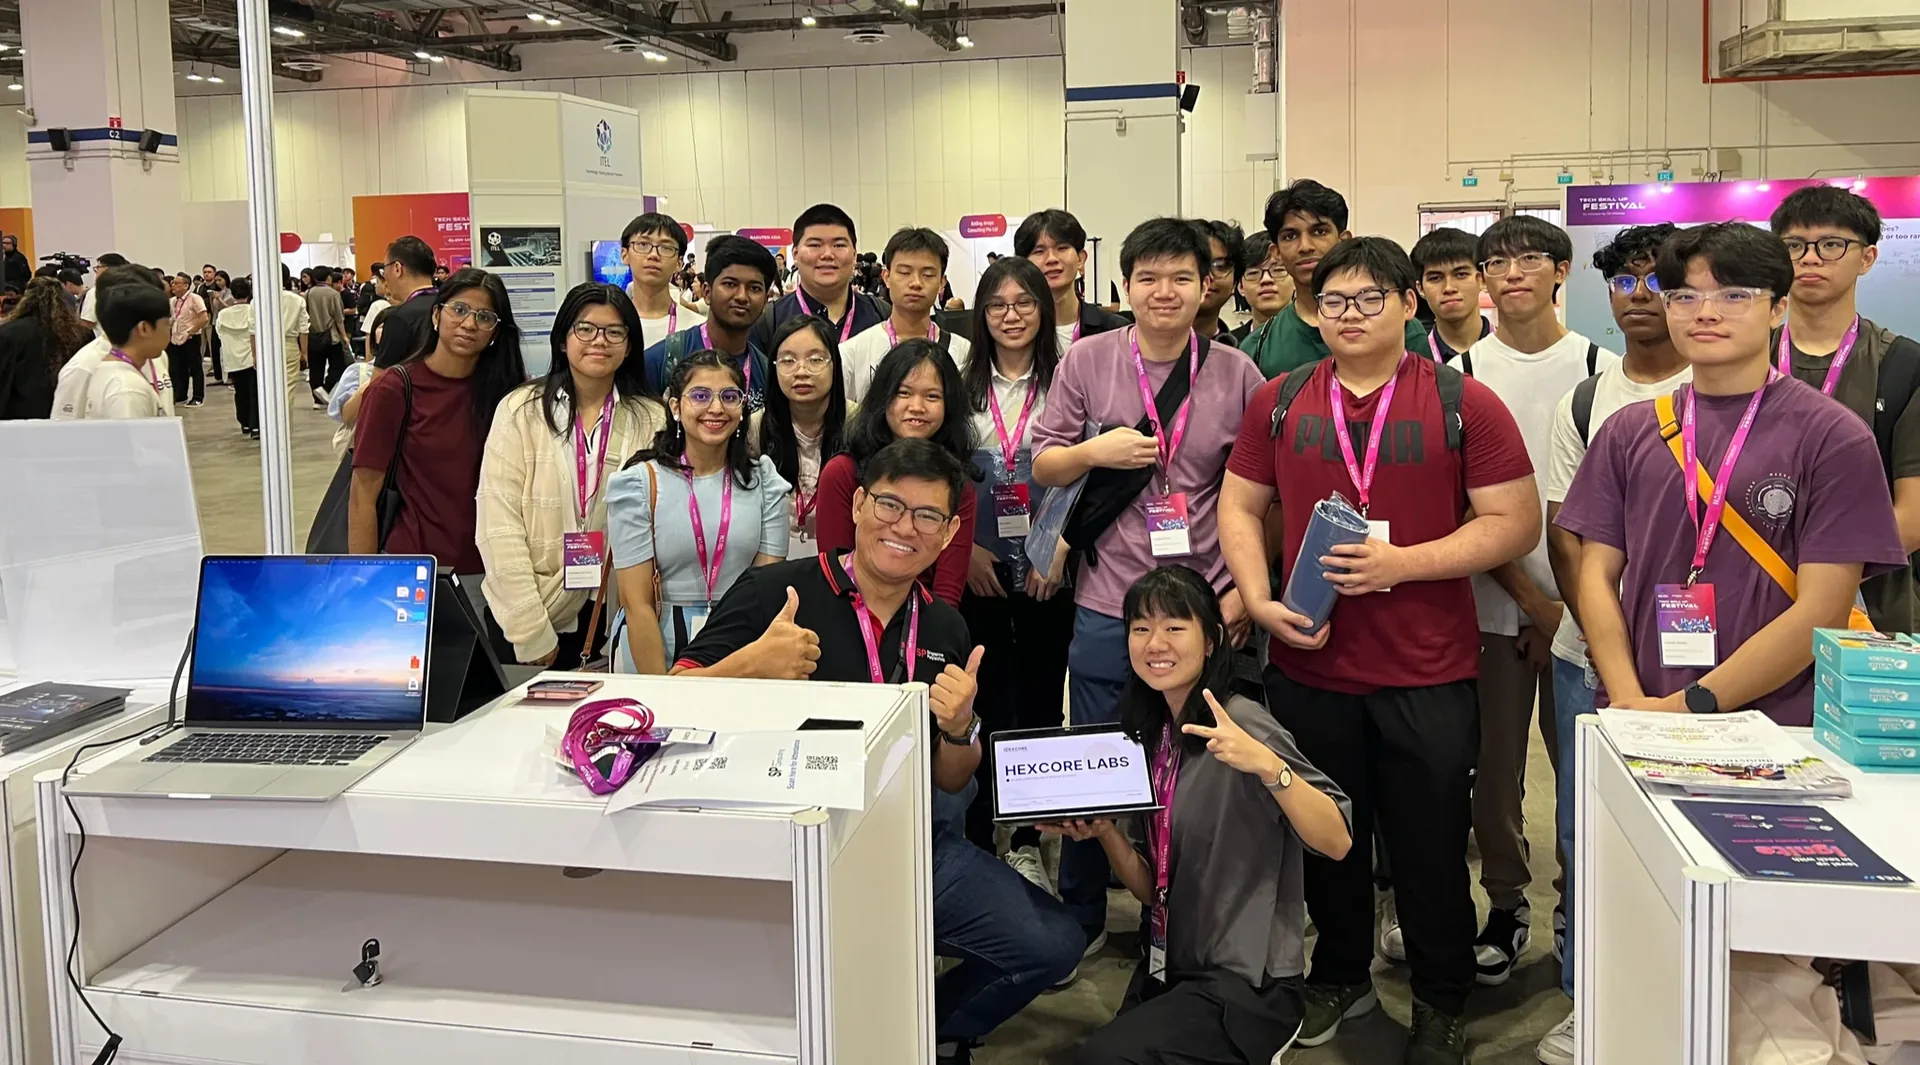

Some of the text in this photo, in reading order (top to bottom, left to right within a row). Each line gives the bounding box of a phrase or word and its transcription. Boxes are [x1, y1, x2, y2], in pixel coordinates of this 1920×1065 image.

[109, 130, 120, 139] C2
[1583, 201, 1647, 210] FESTIVAL
[916, 647, 926, 658] SP
[1005, 756, 1130, 777] HEXCORE LABS
[1753, 843, 1848, 857] ignite
